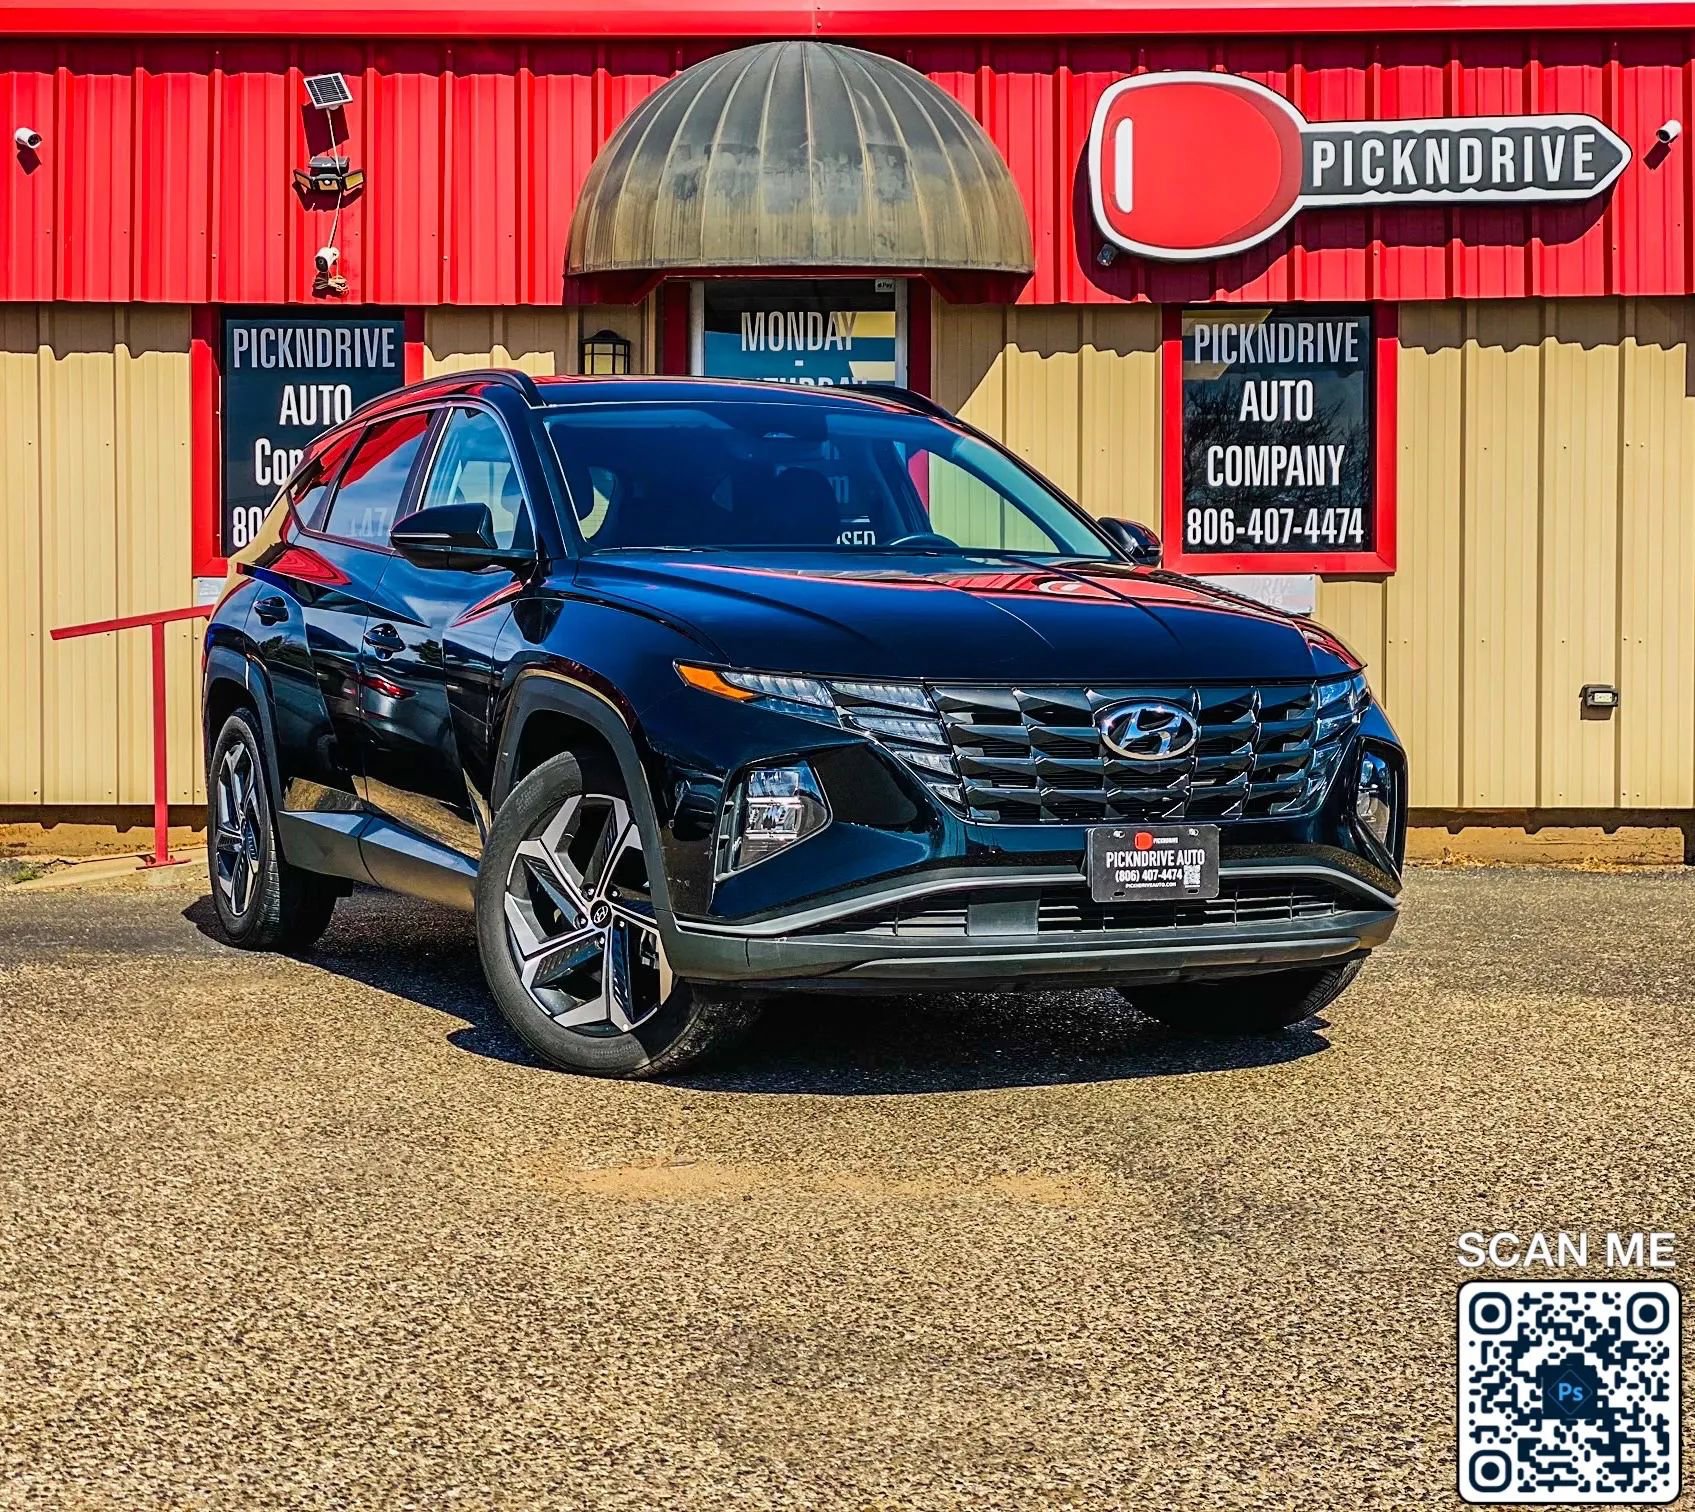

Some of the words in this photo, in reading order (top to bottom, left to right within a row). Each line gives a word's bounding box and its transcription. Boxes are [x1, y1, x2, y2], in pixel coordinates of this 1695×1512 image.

[1312, 133, 1596, 187] PICKNDRIVE
[233, 327, 395, 368] PICKNDRIVE
[741, 311, 857, 351] MONDAY
[1194, 321, 1359, 364] PICKNDRIVE
[279, 384, 352, 426] AUTO
[1238, 379, 1314, 422] AUTO
[1207, 444, 1345, 487] COMPANY
[1186, 507, 1365, 546] 806-407-4474
[1105, 850, 1175, 868] PICKNDRIVE
[1176, 849, 1206, 865] AUTO
[1115, 869, 1140, 883] (806)
[1141, 868, 1183, 881] 407-4474
